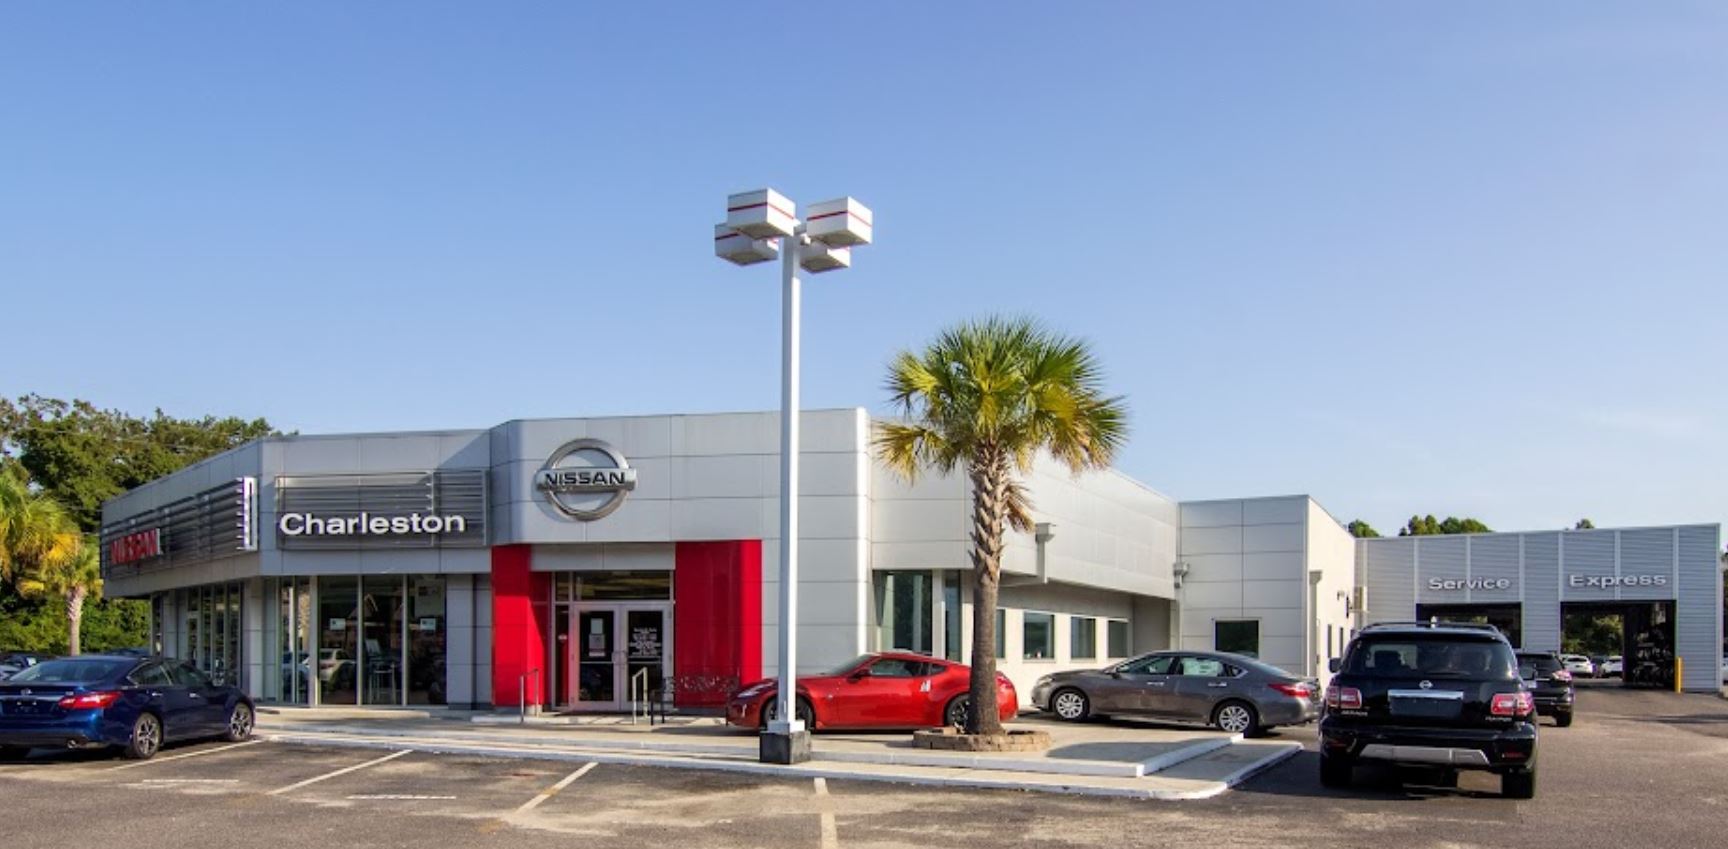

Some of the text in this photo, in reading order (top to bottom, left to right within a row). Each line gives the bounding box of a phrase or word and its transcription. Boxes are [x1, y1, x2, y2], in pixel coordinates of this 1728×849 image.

[545, 471, 625, 485] NISSAN
[279, 512, 465, 535] Charleston
[1428, 574, 1667, 590] Service Express
